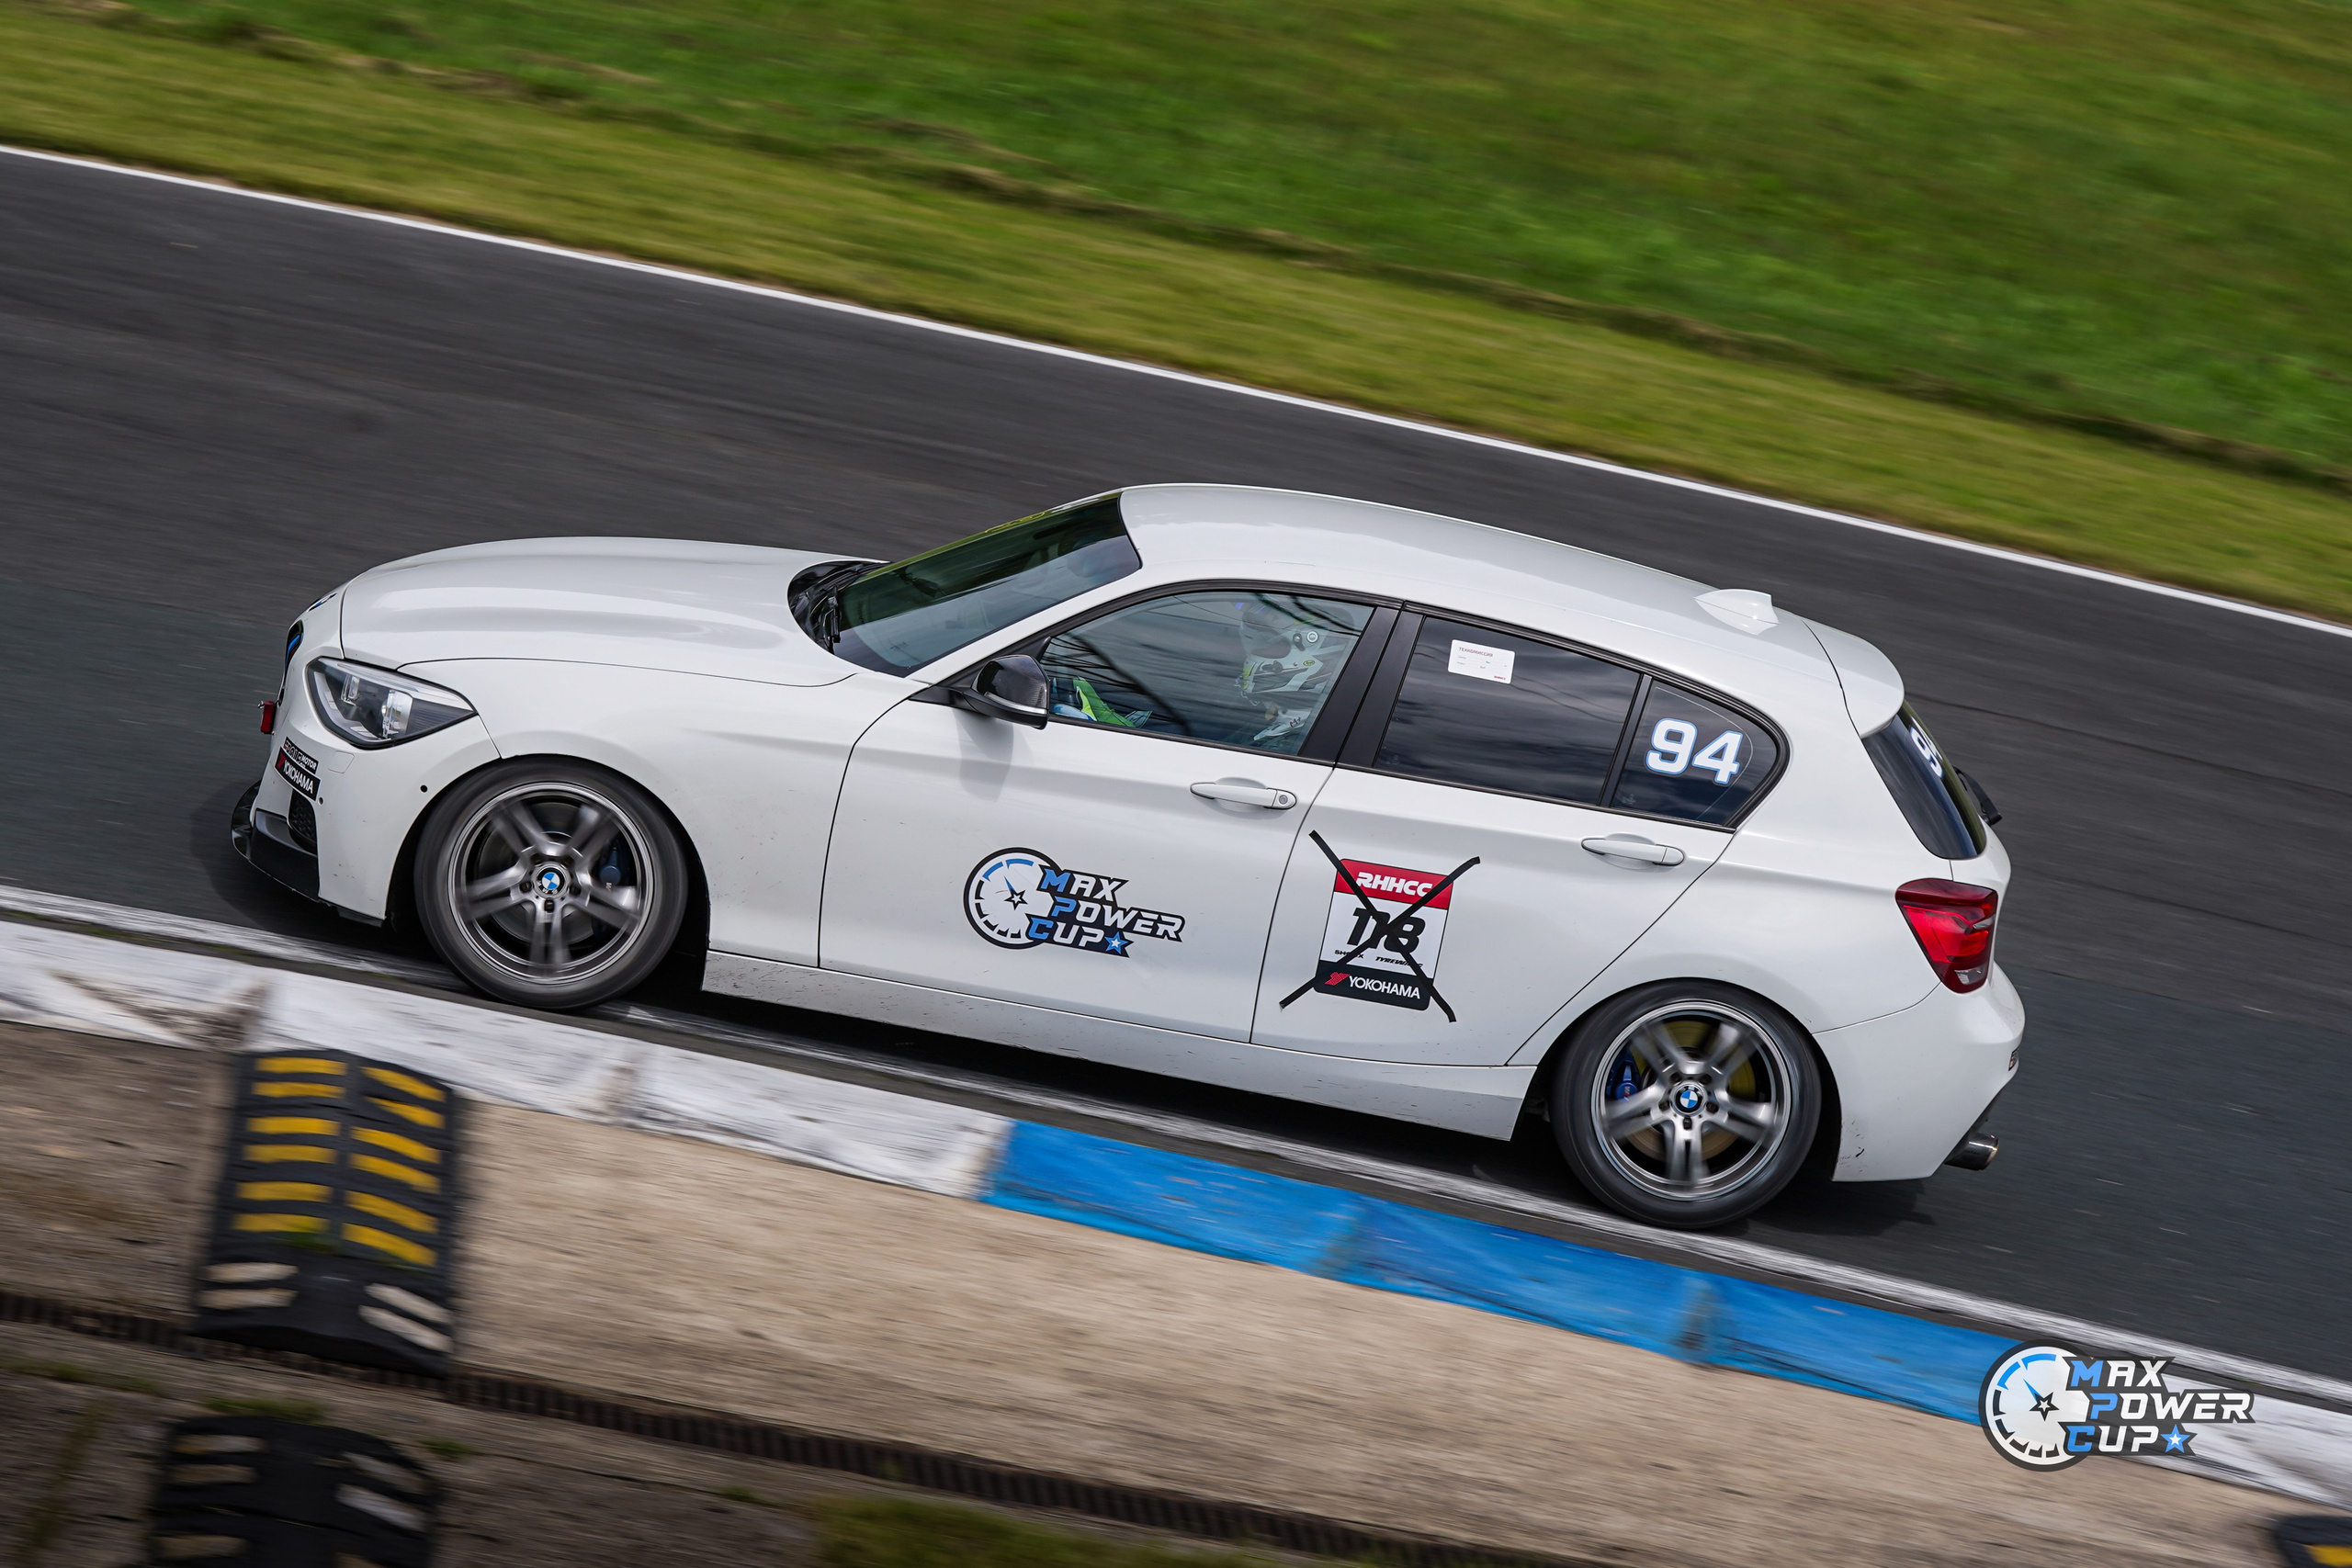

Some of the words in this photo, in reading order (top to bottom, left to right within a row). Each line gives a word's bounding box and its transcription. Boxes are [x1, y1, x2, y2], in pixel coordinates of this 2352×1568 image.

[1645, 717, 1744, 784] 94
[283, 760, 313, 795] YOKOHAMA
[1040, 868, 1123, 902] MAX
[1356, 872, 1433, 898] RHHCC
[1028, 917, 1105, 947] CUP
[1051, 896, 1183, 939] POWER
[1349, 976, 1421, 999] YOKOHAMA
